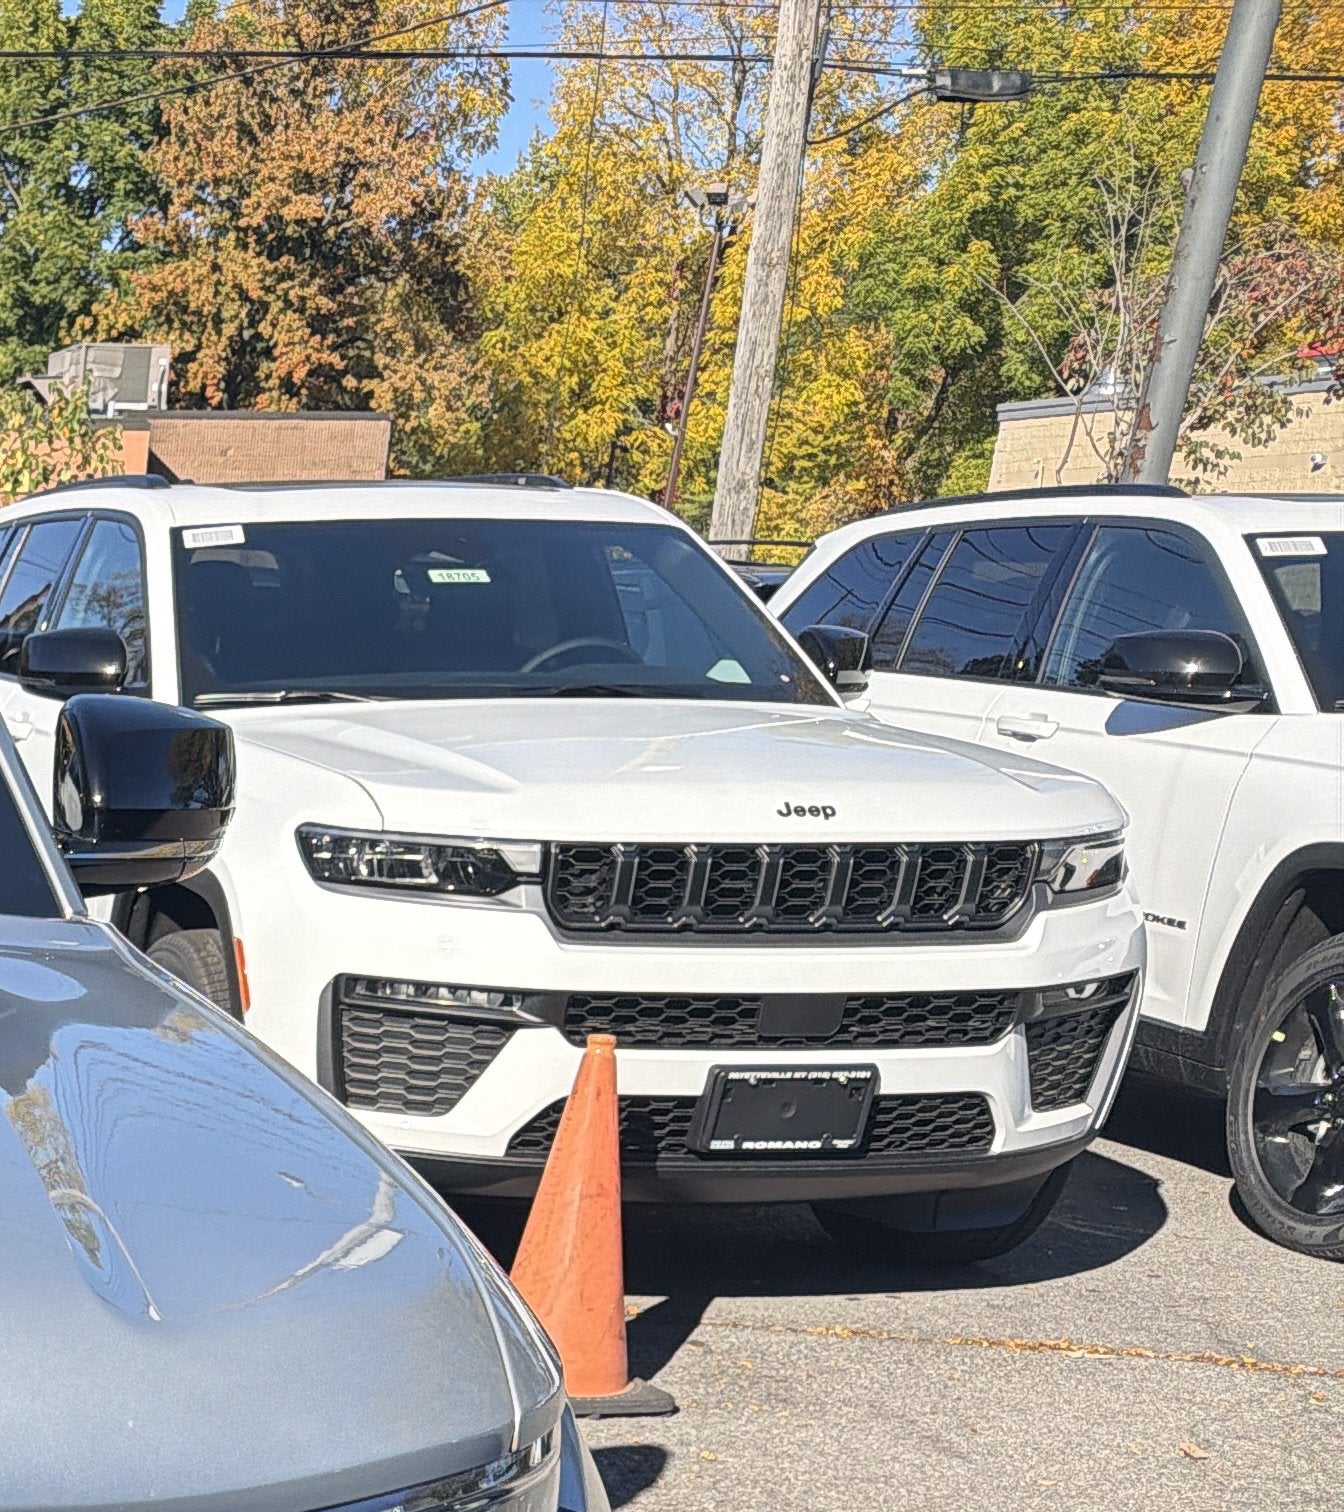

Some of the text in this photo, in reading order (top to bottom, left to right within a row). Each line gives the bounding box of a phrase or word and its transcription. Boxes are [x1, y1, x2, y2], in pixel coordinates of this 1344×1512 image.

[776, 801, 837, 821] Jeep
[1143, 911, 1187, 930] OKEE
[741, 1140, 822, 1150] ROMANO
